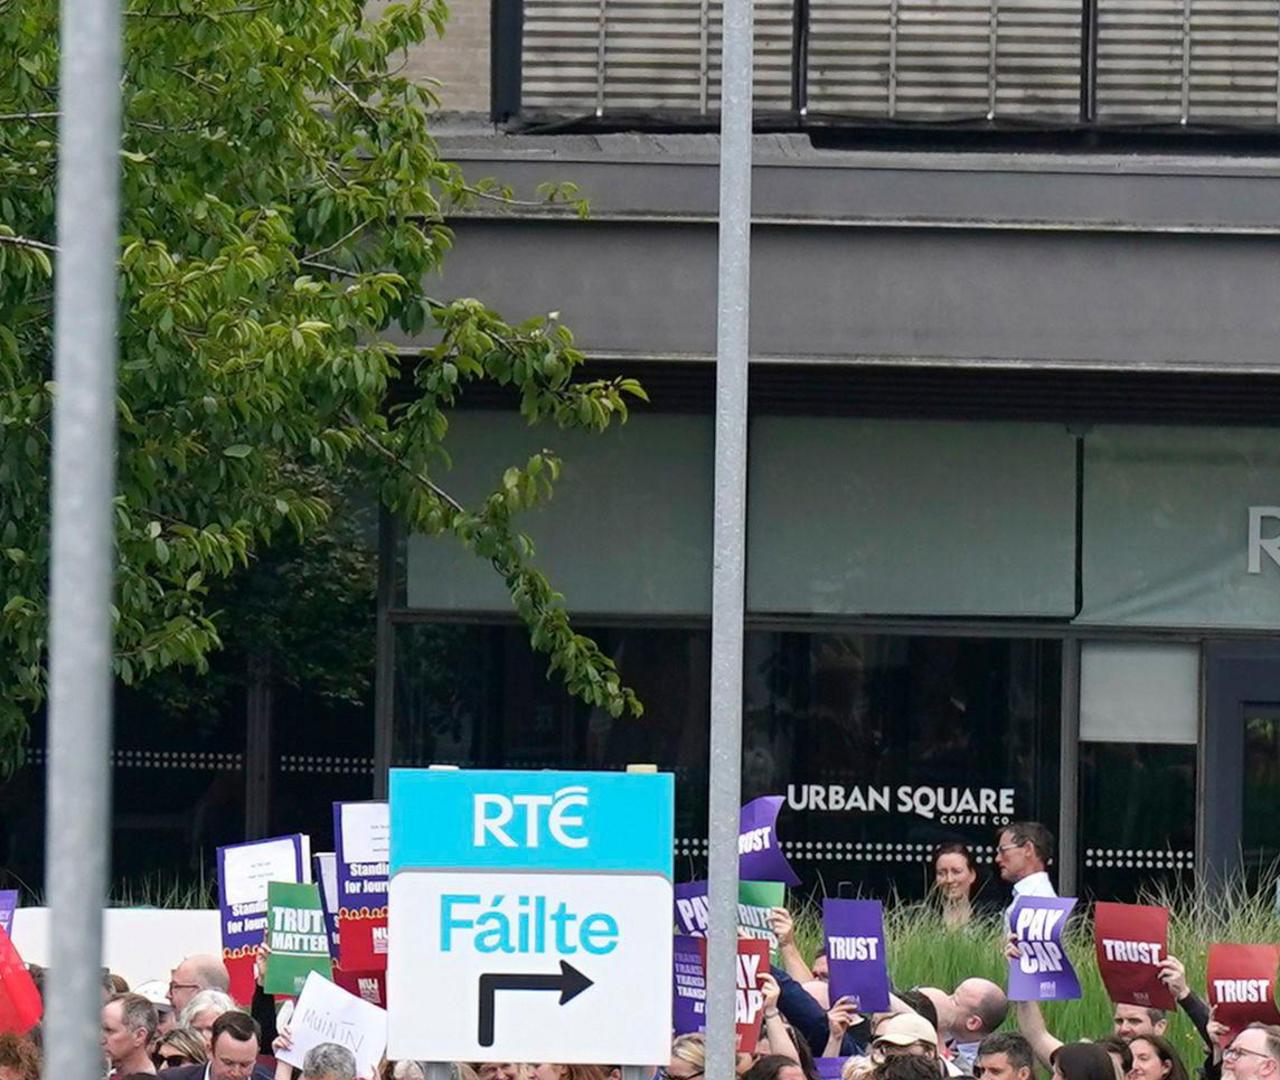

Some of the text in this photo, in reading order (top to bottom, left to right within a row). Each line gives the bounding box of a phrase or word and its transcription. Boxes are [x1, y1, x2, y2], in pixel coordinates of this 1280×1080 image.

[787, 784, 1014, 819] URBAN SQUARE
[473, 786, 589, 848] RTÉ
[940, 815, 987, 825] COFFEE
[344, 881, 360, 894] for
[227, 920, 243, 934] for
[439, 893, 620, 955] Fáilte
[1017, 908, 1064, 941] PAY
[828, 936, 878, 961] TRUST
[1017, 942, 1063, 974] CAP
[1102, 939, 1162, 966] TRUST
[1214, 979, 1270, 1003] TRUST
